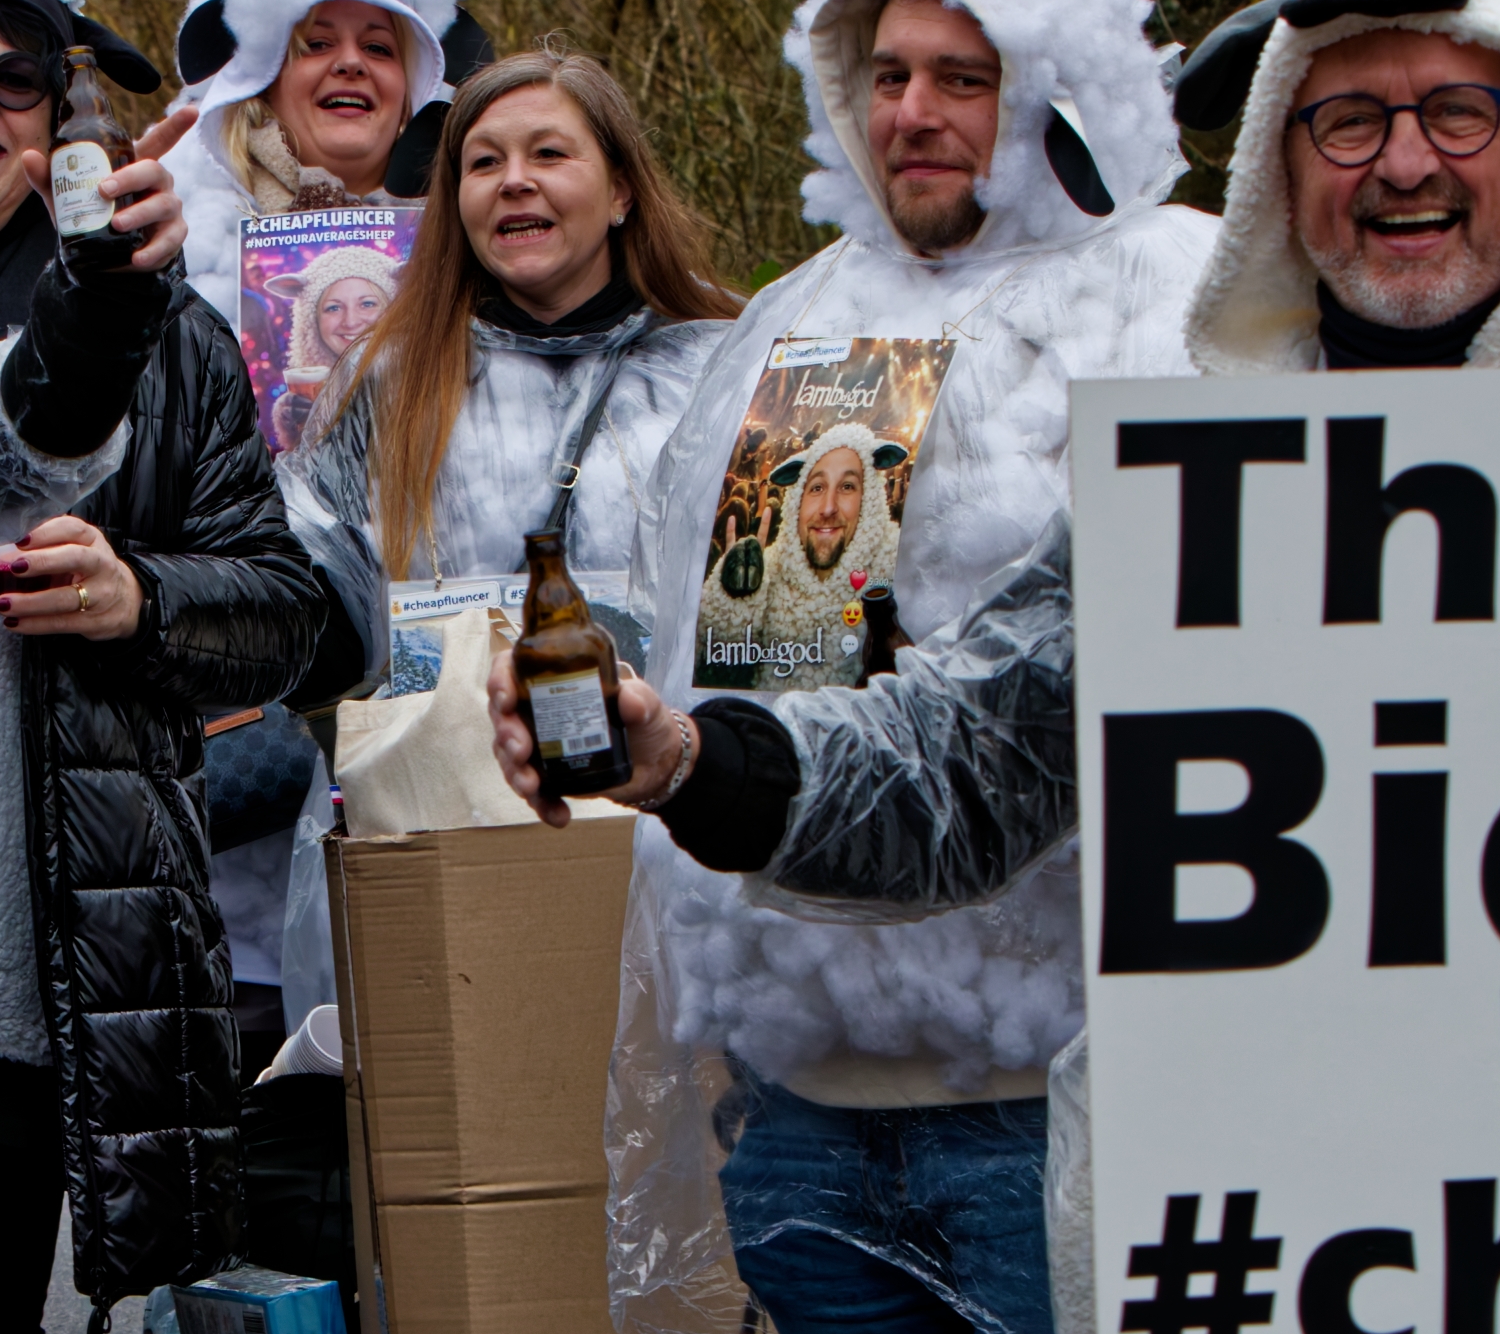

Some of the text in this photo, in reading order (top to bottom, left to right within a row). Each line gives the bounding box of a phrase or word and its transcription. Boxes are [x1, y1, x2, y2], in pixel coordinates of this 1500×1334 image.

[246, 210, 396, 234] #CHEAPFLUENCER
[244, 230, 396, 249] #NOTYOURAVERAGESHEEP
[403, 590, 491, 612] #cheapfluencer
[706, 623, 762, 666] lamb
